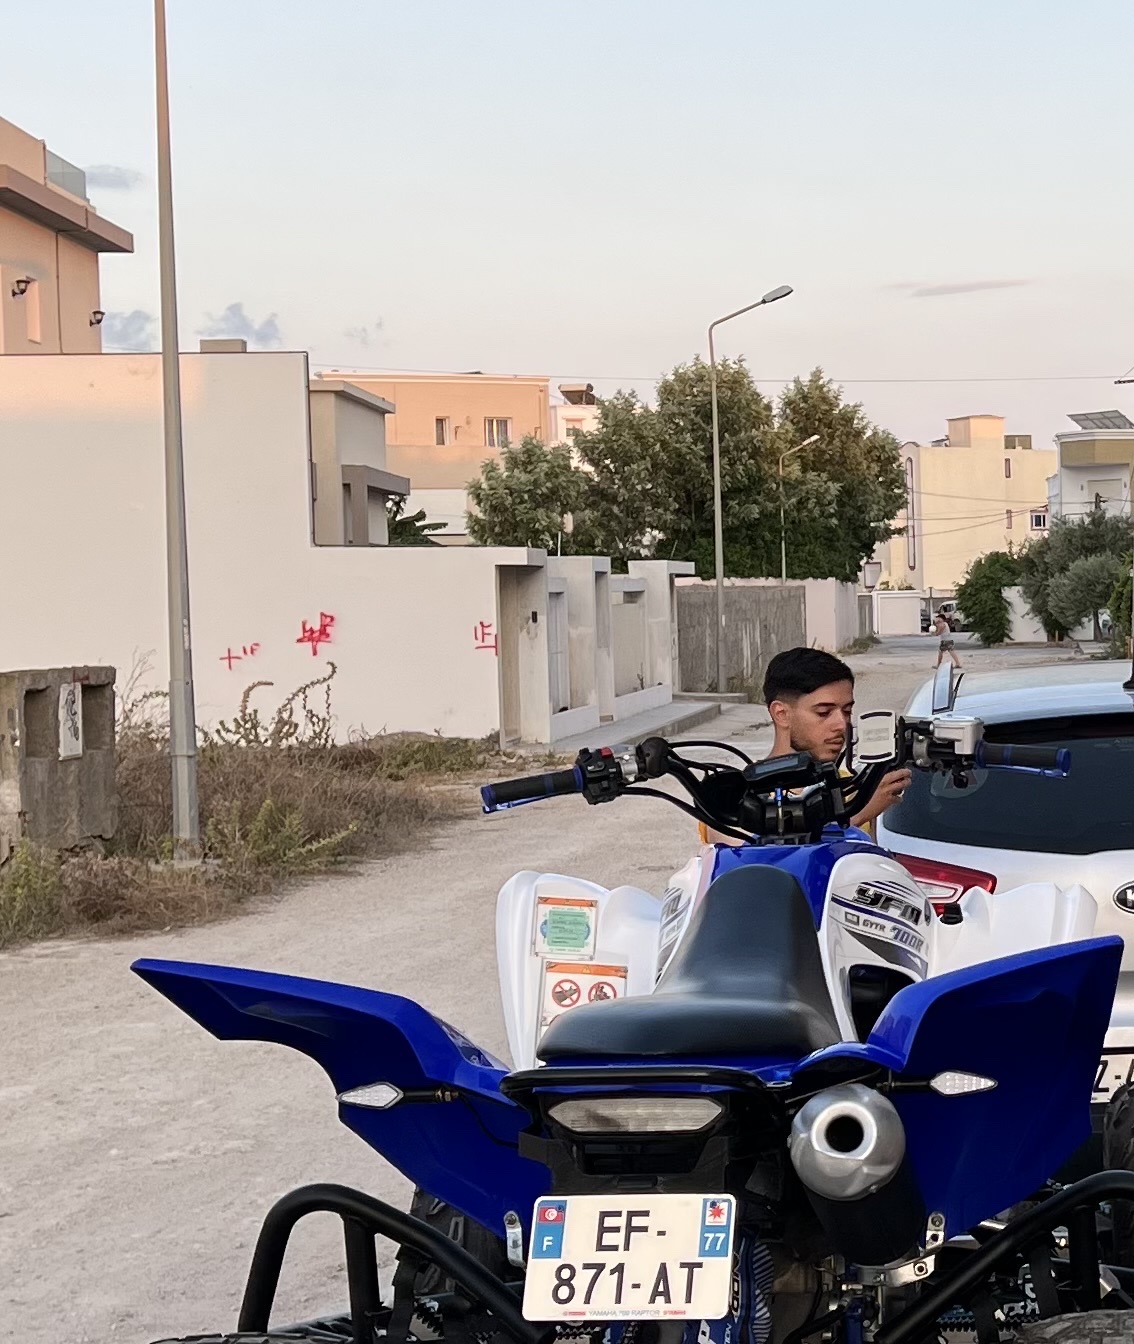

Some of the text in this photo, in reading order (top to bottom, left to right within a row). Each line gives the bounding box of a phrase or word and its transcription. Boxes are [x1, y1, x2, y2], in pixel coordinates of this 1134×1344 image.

[862, 918, 887, 933] GYTR
[595, 1209, 667, 1253] EF-
[542, 1235, 554, 1252] F
[703, 1232, 726, 1252] 77
[551, 1261, 704, 1306] 871-AT
[588, 1309, 616, 1317] YAMAHA
[631, 1308, 661, 1317] RAPTOR
